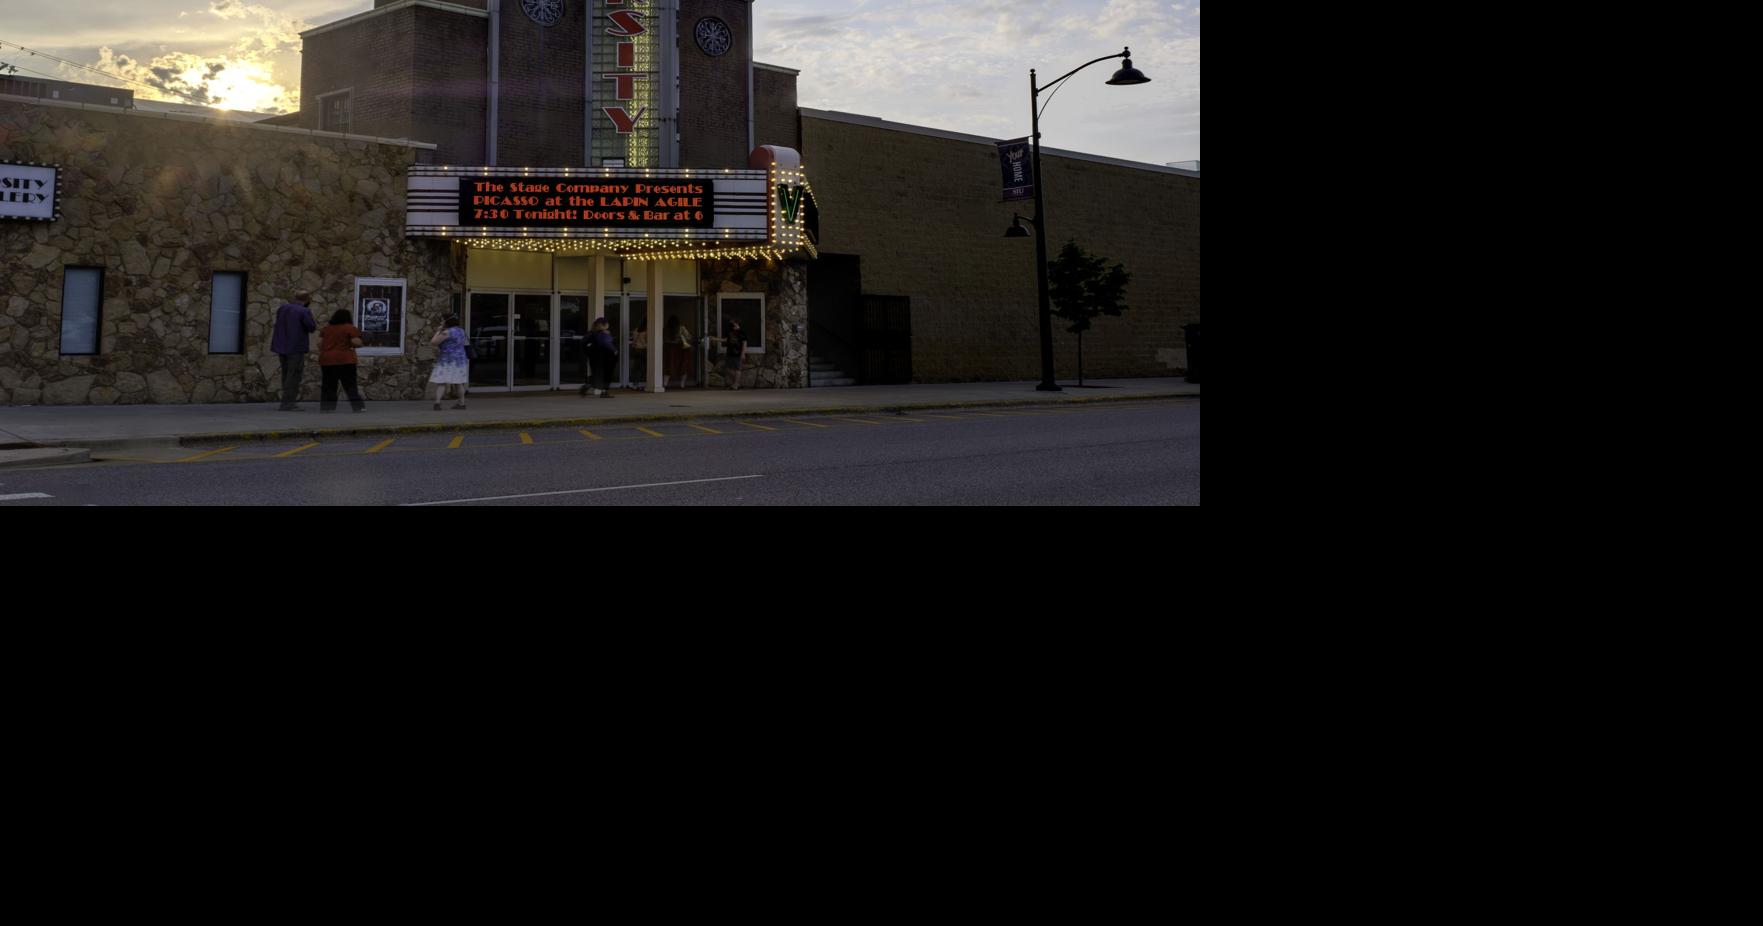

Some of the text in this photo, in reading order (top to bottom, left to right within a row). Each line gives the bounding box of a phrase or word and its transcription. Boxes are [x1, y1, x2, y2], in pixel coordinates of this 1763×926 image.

[602, 0, 649, 133] SITY
[1012, 161, 1024, 182] HOME
[0, 177, 48, 190] SITY
[474, 181, 704, 194] The Stage Company Presents
[473, 195, 703, 207] PICASSO at the LAPIN AGILE
[777, 183, 804, 225] V
[474, 208, 703, 220] 7:30 Tonight! Doors & Bar at 6
